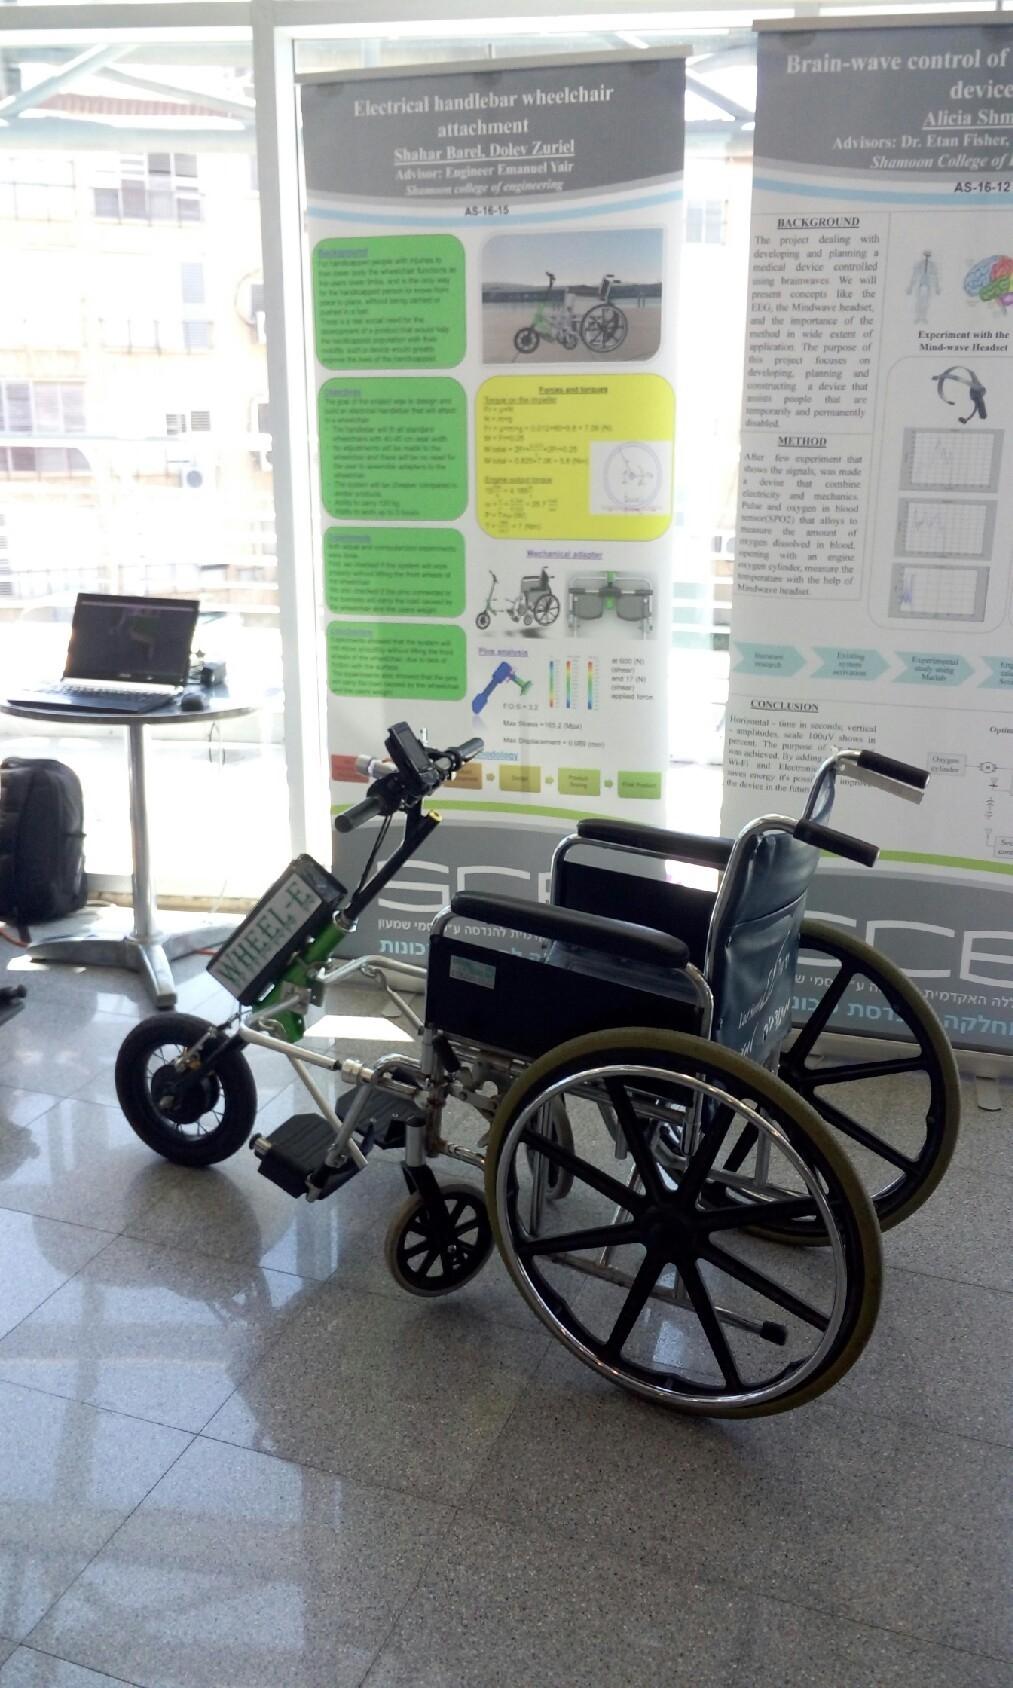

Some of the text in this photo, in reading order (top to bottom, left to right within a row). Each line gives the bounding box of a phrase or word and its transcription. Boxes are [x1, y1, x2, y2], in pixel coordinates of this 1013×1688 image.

[787, 48, 1010, 74] Brain-wave control of
[354, 85, 614, 117] Electrical handlebar wheelchair
[923, 111, 971, 127] Alicia
[438, 118, 529, 137] attachment
[833, 138, 897, 150] Advisors:
[901, 135, 922, 148] Dr.
[927, 134, 959, 148] Etan
[394, 147, 442, 163] Shahar
[532, 140, 575, 155] Zuriel
[871, 154, 1007, 170] Shamoon College of
[446, 165, 494, 178] Engineer
[498, 163, 547, 176] Emanuel
[504, 179, 564, 192] engineering
[777, 216, 860, 229] BACKGROUND
[755, 234, 879, 246] The project dealing with
[807, 248, 822, 257] and
[829, 249, 867, 259] planning
[753, 262, 877, 272] medical device controlled
[839, 276, 852, 284] We
[918, 330, 1010, 341] Experiment with the
[823, 344, 857, 353] purpose
[920, 343, 1008, 351] Mind-wave Headset
[778, 436, 827, 448] METHOD
[527, 550, 570, 559] Mechanical
[751, 699, 819, 713] CONCLUSION
